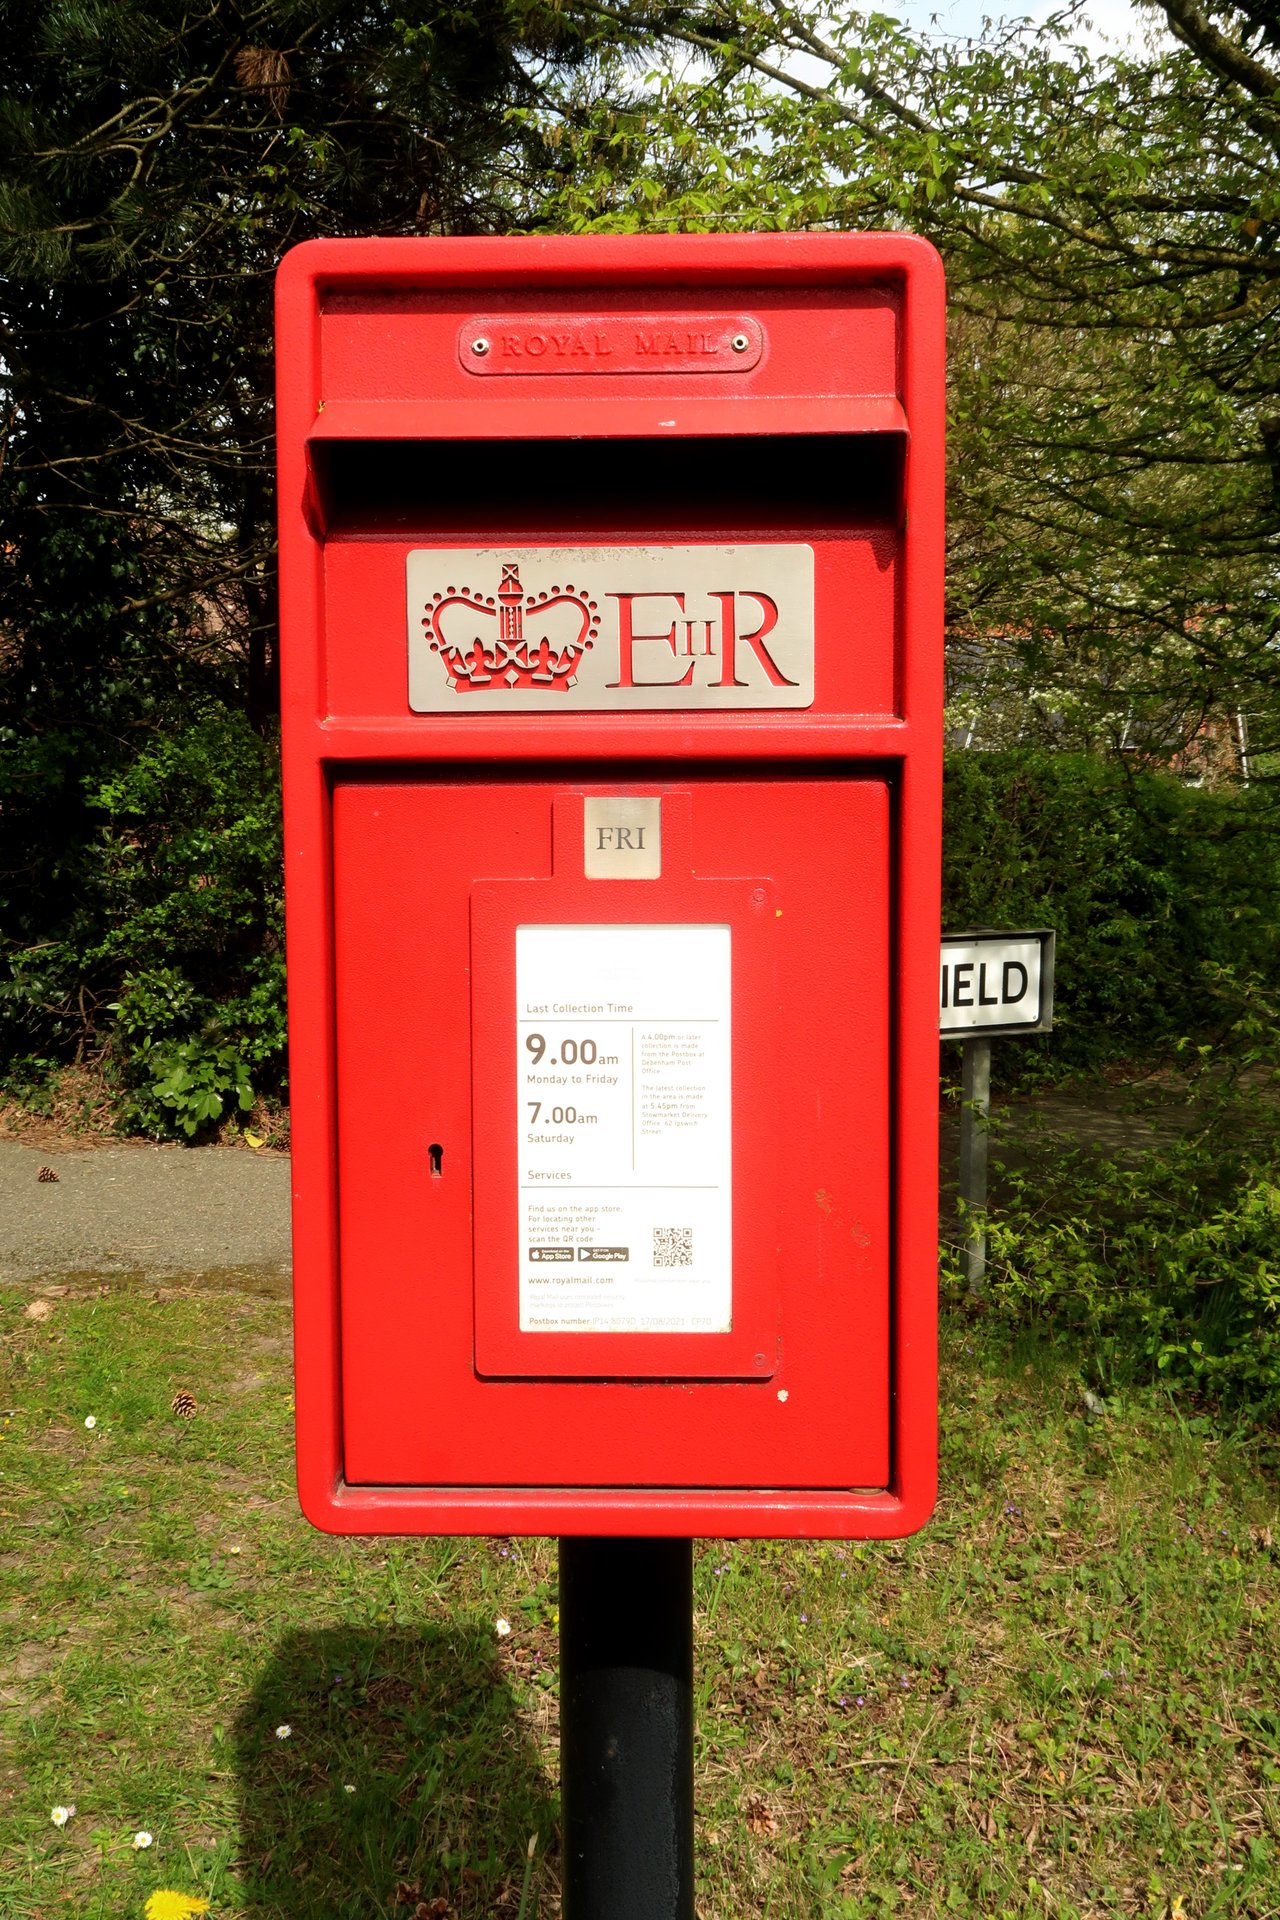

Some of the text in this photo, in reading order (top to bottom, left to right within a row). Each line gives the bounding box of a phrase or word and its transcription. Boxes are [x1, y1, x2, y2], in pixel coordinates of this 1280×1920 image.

[502, 333, 718, 356] ROYAL MAIL
[596, 827, 646, 850] FRI
[526, 1003, 633, 1013] Last Collection Time
[525, 1033, 619, 1065] 9.00am
[527, 1074, 618, 1085] Monday to Friday
[527, 1101, 598, 1124] 7.00am
[527, 1133, 575, 1144] Saturday
[528, 1170, 572, 1180] Services
[585, 1206, 599, 1214] app
[543, 1215, 573, 1224] locating
[528, 1225, 559, 1233] services
[561, 1225, 578, 1233] near
[581, 1226, 595, 1234] you
[528, 1235, 545, 1243] scan
[562, 1235, 574, 1243] QR
[592, 1253, 626, 1261] Google Play
[528, 1276, 614, 1285] www.royalmail.com
[529, 1317, 590, 1325] Postbox number
